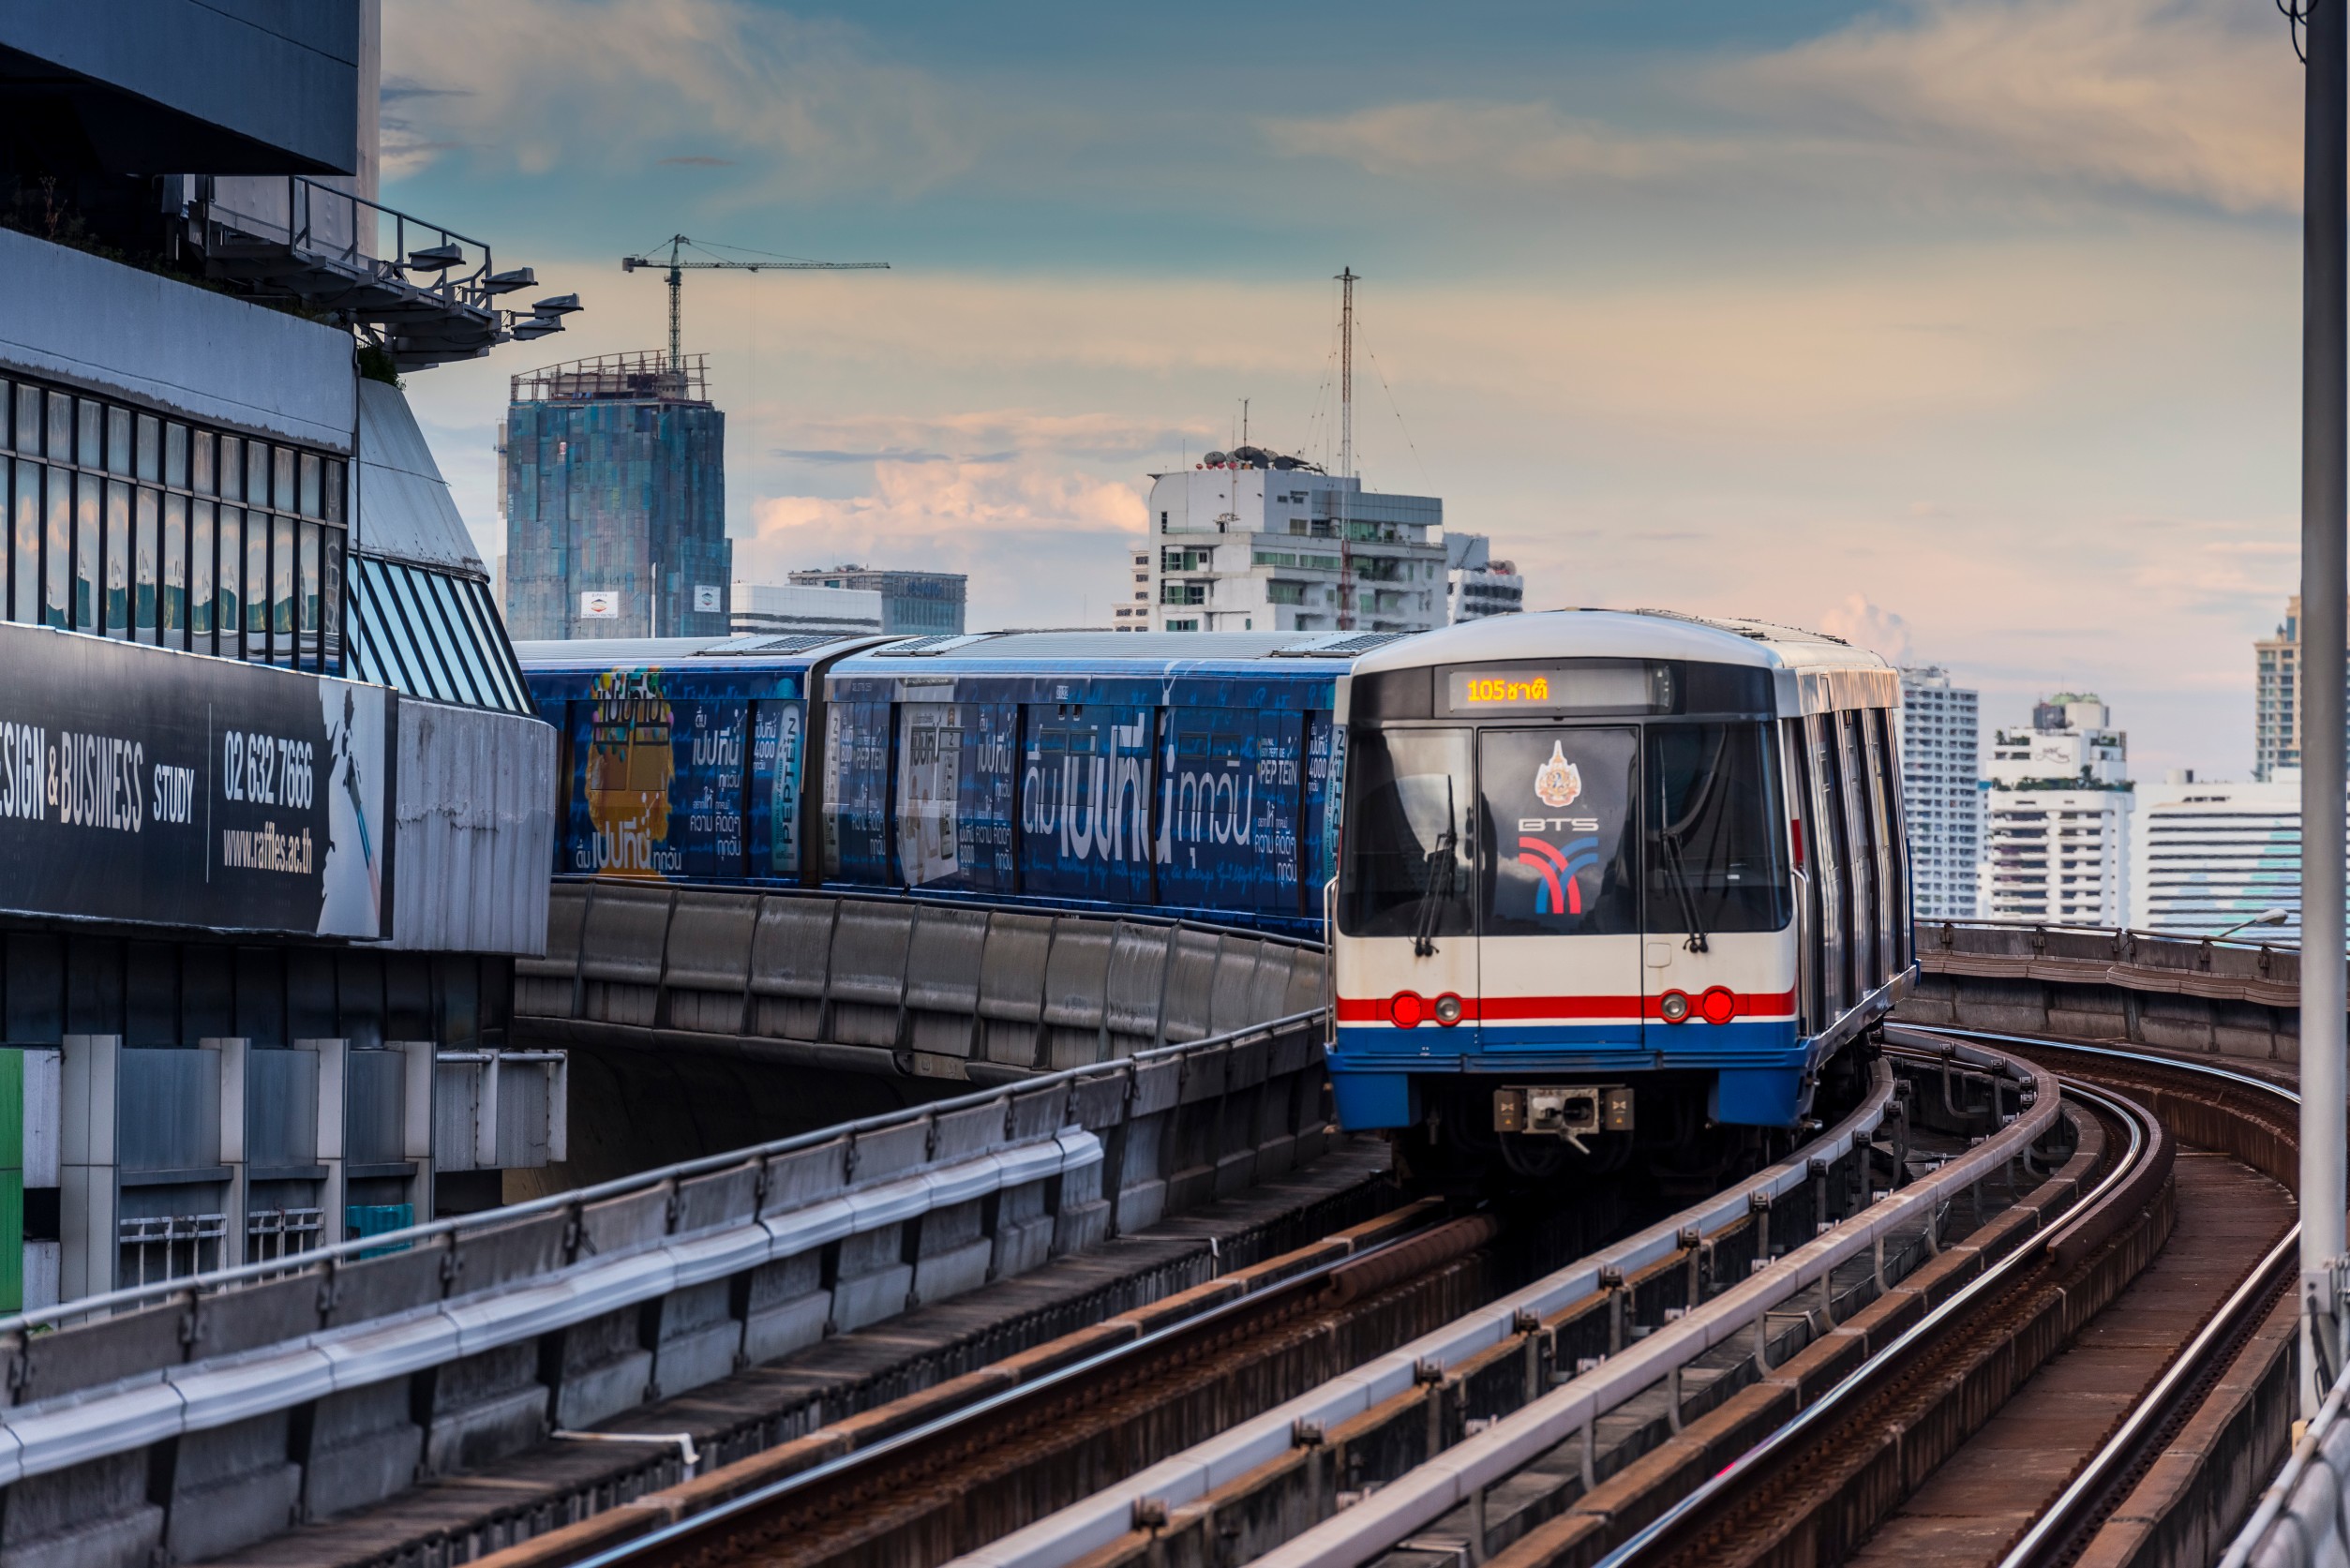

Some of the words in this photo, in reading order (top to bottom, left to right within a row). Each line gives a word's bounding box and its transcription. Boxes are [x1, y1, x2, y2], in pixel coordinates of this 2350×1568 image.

[754, 740, 775, 759] 4000
[0, 721, 45, 821] SIGN
[48, 745, 58, 806] &
[61, 731, 143, 833] BUSINESS
[153, 763, 194, 824] STUDY
[224, 730, 243, 801] 02
[247, 733, 275, 804] 632
[278, 739, 313, 810] 7666
[1309, 757, 1326, 779] 4000
[1519, 818, 1599, 832] BTS
[223, 820, 312, 874] www.raffles.ac.th
[717, 835, 741, 861] ทุกวัน
[1277, 858, 1297, 889] ทุกวัน
